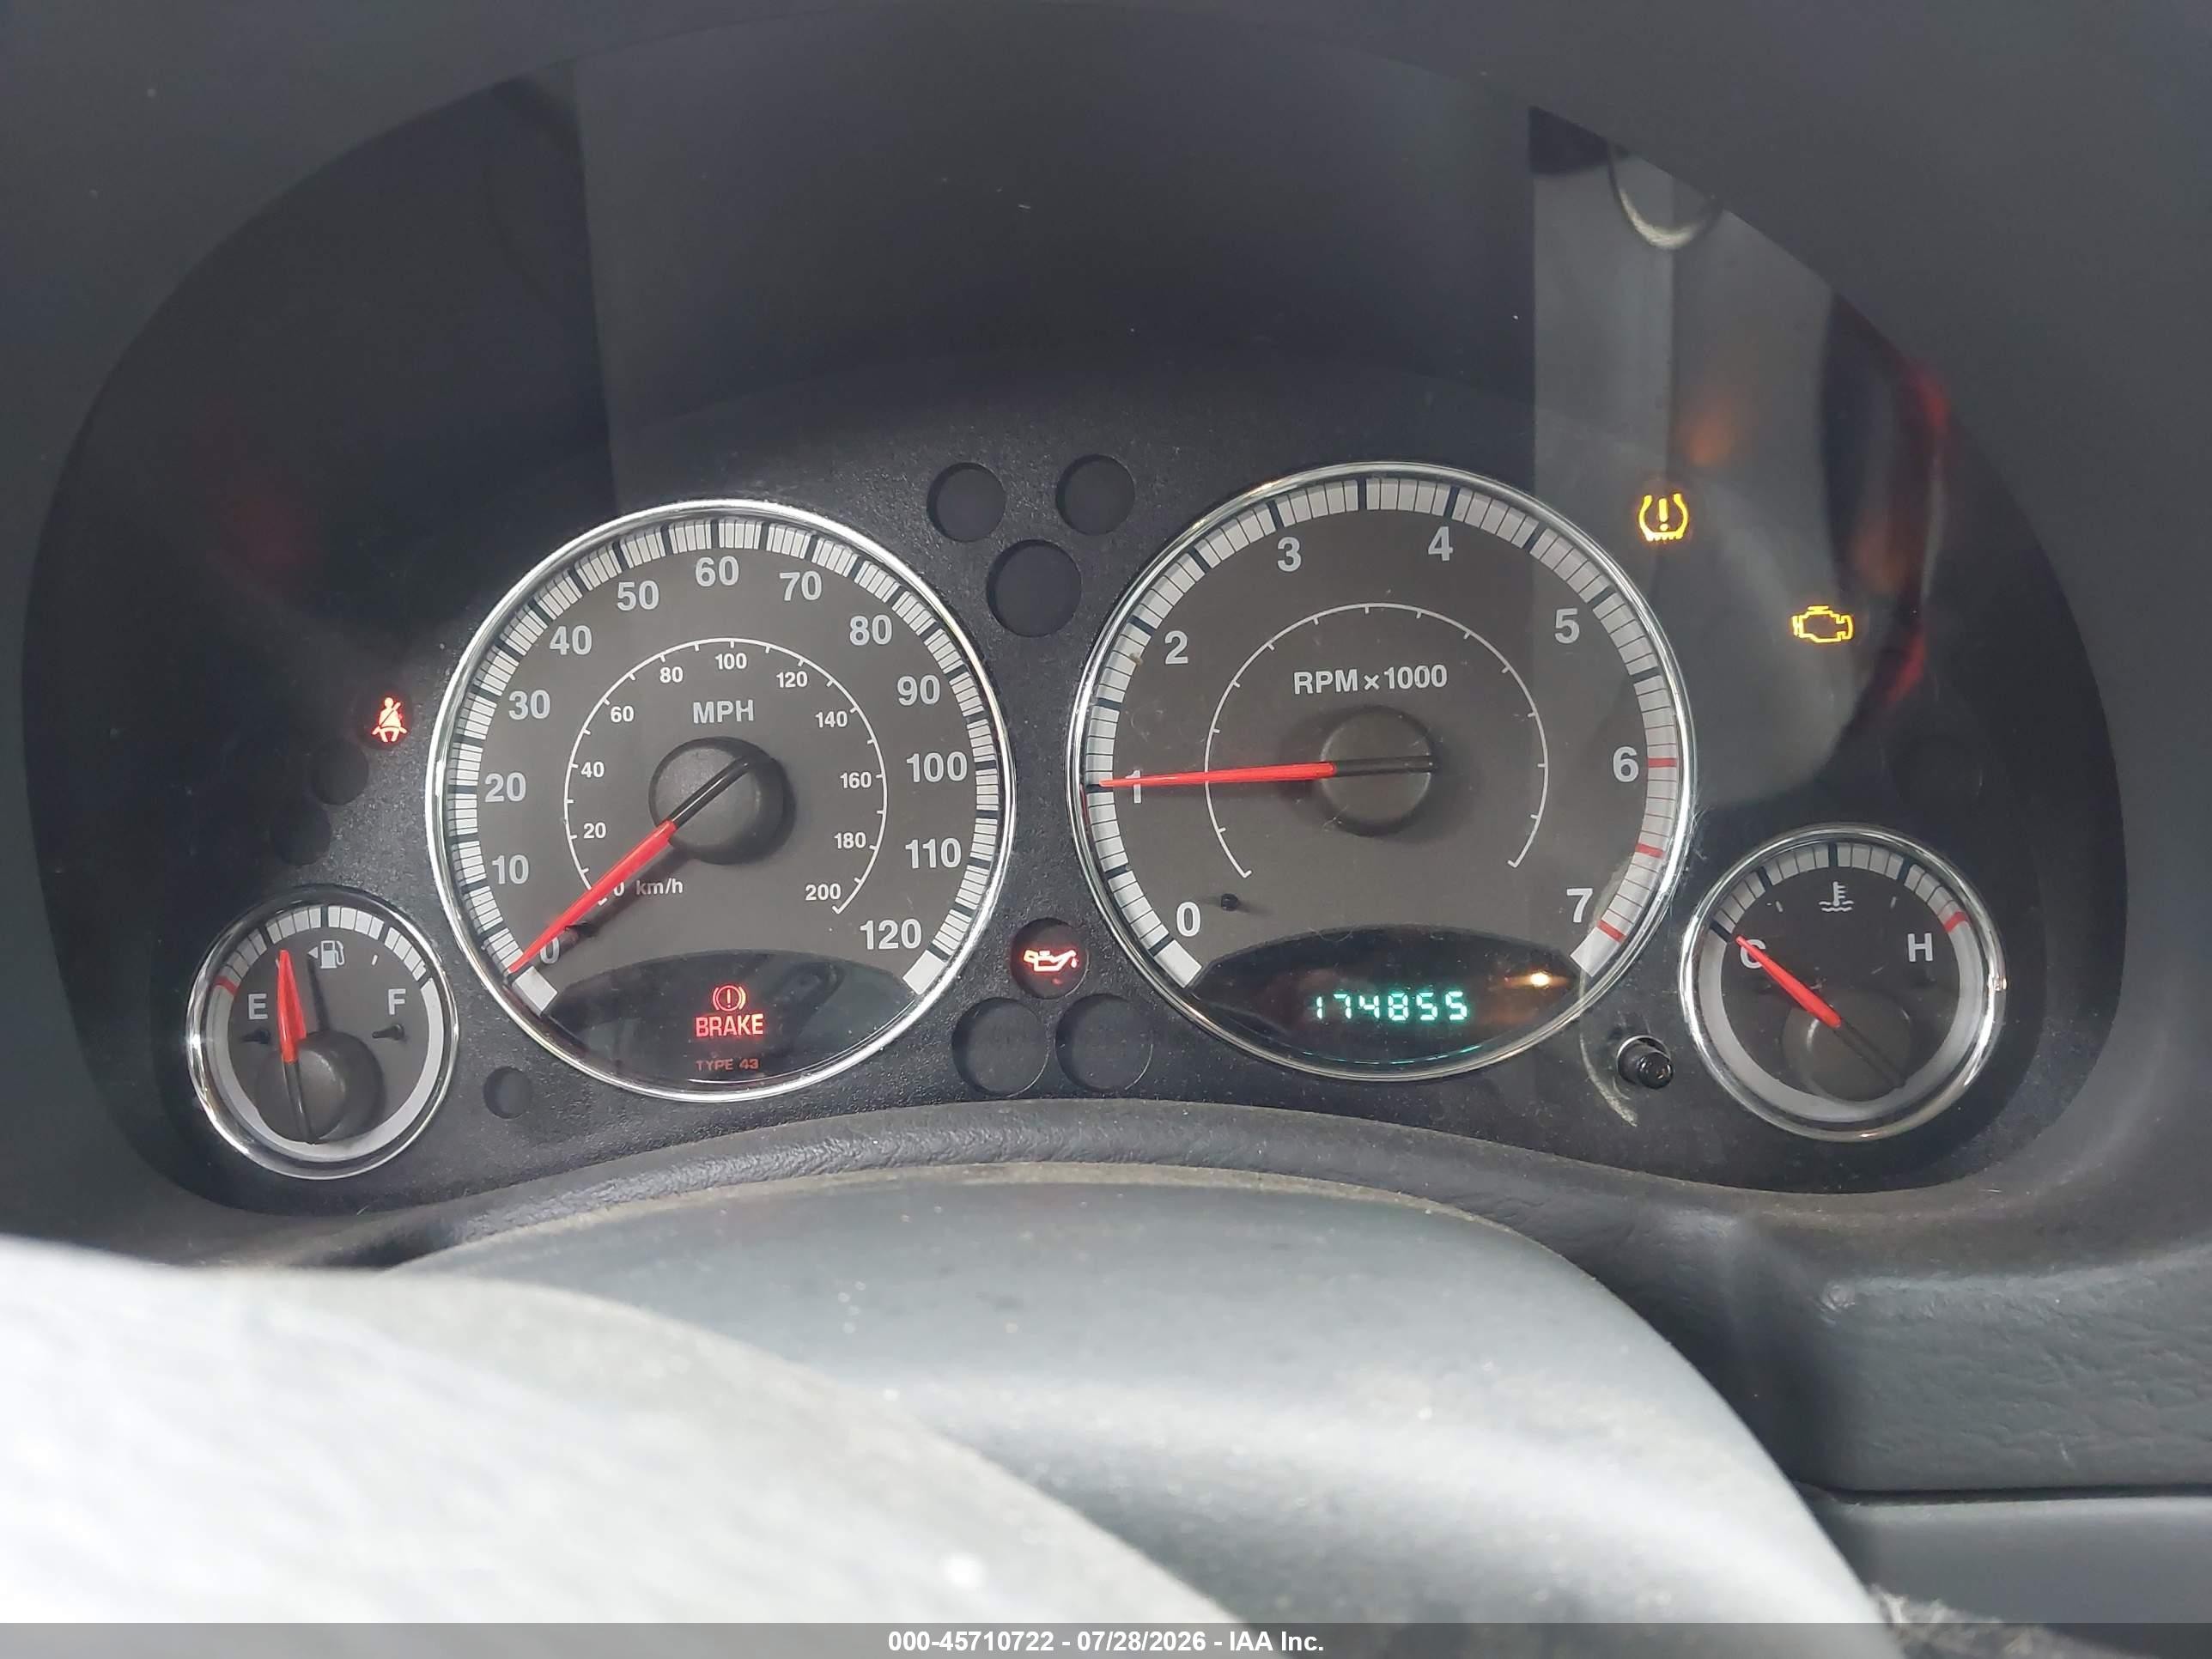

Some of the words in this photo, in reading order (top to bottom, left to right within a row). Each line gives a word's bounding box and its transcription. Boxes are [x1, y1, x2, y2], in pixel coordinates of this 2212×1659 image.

[1278, 537, 1301, 572] 3
[1428, 526, 1453, 562] 4
[695, 556, 739, 586] 60
[780, 571, 823, 600] 70
[617, 580, 659, 610] 50
[550, 625, 592, 655] 40
[849, 615, 892, 645] 80
[1555, 609, 1579, 644] 5
[715, 653, 747, 671] 100
[1165, 630, 1188, 665] 2
[660, 666, 684, 684] 80
[776, 672, 808, 689] 120
[897, 675, 940, 704] 90
[508, 690, 550, 720] 30
[611, 707, 635, 723] 60
[693, 700, 755, 724] MPH
[816, 710, 848, 727] 140
[581, 762, 605, 779] 40
[906, 751, 967, 782] 100
[1613, 747, 1638, 781] 6
[485, 773, 526, 802] 20
[840, 772, 872, 789] 160
[1124, 769, 1142, 804] 1
[584, 823, 606, 840] 20
[835, 832, 866, 849] 180
[905, 837, 961, 867] 110
[492, 854, 528, 884] 10
[635, 878, 684, 896] km/h
[805, 884, 842, 901] 200
[1176, 902, 1201, 936] 0
[1567, 888, 1593, 922] 7
[860, 919, 921, 949] 120
[1907, 933, 1934, 963] H
[540, 937, 560, 964] 0
[1740, 939, 1766, 969] C
[248, 993, 268, 1019] E
[388, 988, 407, 1015] F
[1313, 992, 1468, 1021] 174855
[696, 1013, 764, 1037] BRAKE
[696, 1059, 733, 1071] TYPE
[739, 1058, 758, 1070] 43
